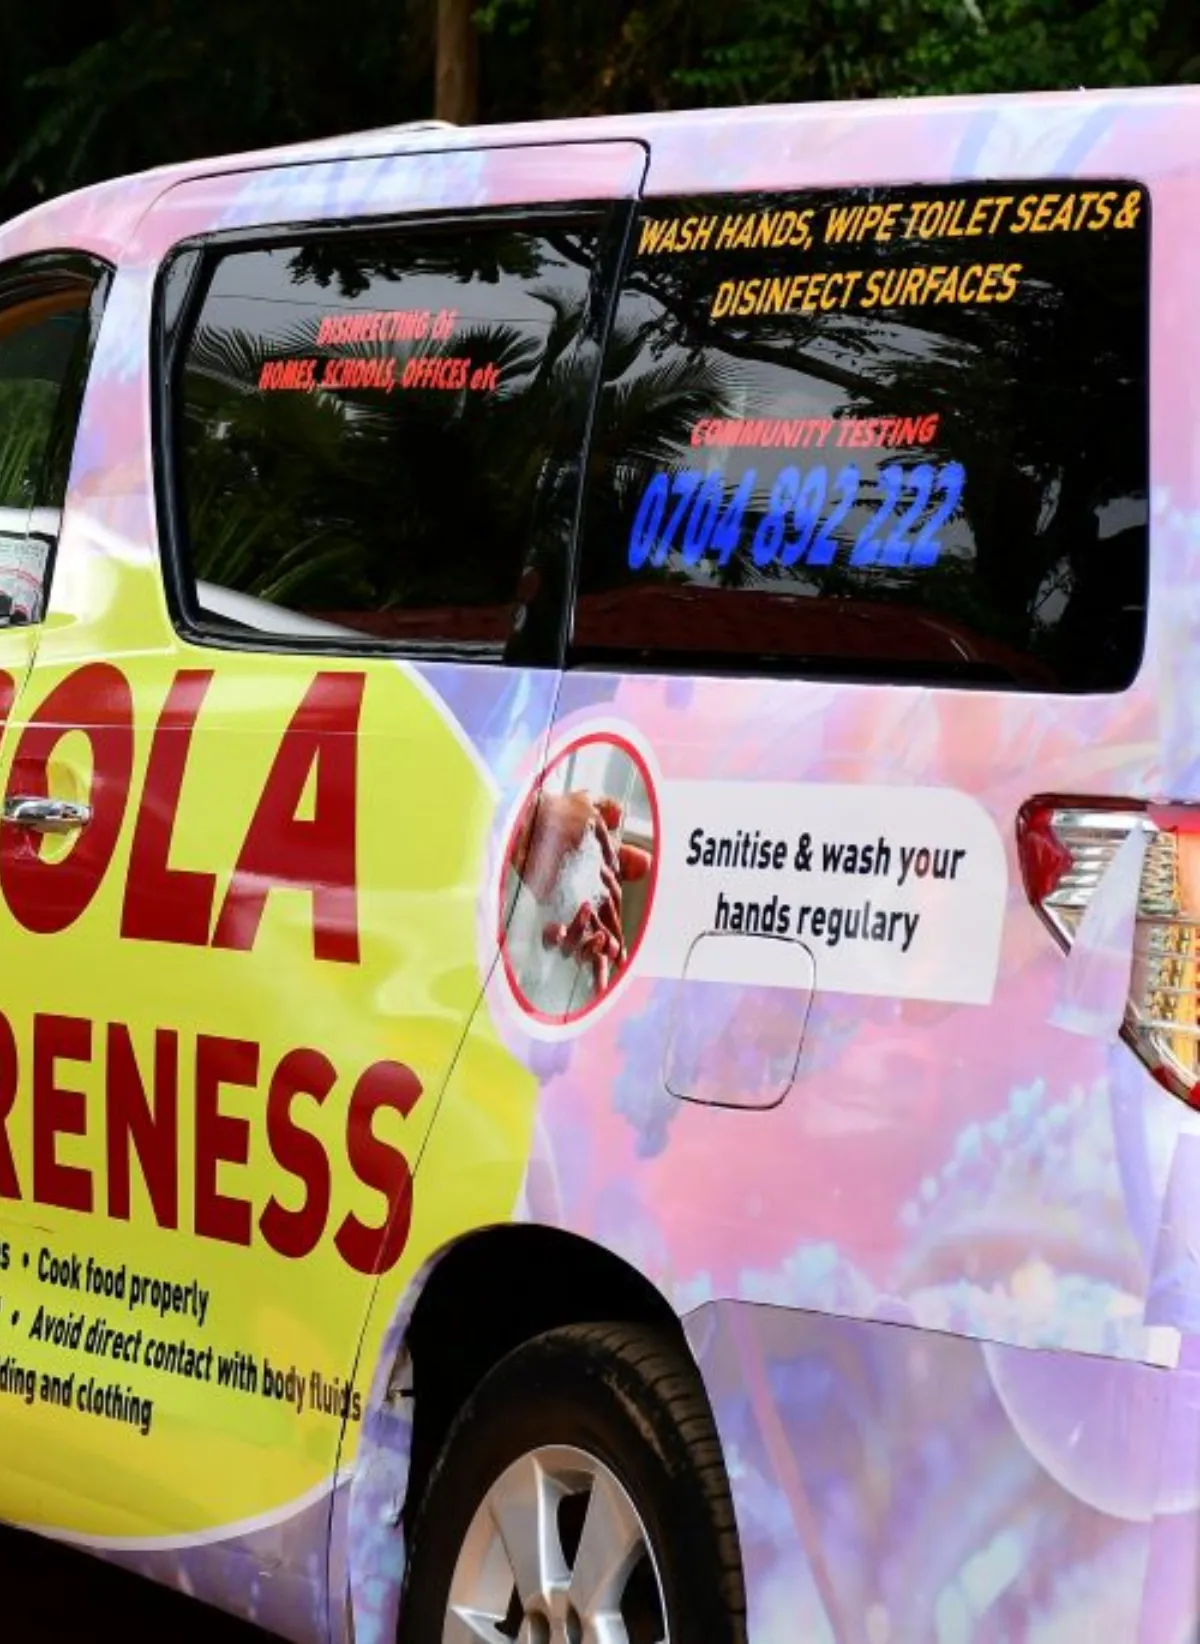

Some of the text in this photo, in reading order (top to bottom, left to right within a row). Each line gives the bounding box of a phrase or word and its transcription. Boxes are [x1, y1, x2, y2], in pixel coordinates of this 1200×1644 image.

[637, 190, 1141, 254] WASH HANDS, WIPE TOILET SEATS &
[711, 262, 1023, 318] DISINFECT SURFACES
[402, 356, 471, 390] OFFICES
[690, 413, 941, 448] COMMUNITY TESTING
[626, 460, 966, 572] 0704 892 222
[686, 828, 966, 887] Sanitise & wash your
[714, 892, 921, 952] hands regulary
[38, 1247, 81, 1290] Cook
[85, 1257, 126, 1300] food
[129, 1274, 210, 1327] properly
[28, 1305, 83, 1350] Avoid
[83, 1317, 143, 1362] direct
[143, 1338, 213, 1382] contact
[218, 1350, 258, 1393] with
[262, 1356, 306, 1415] body
[308, 1370, 362, 1422] fluids
[39, 1372, 75, 1408] and
[75, 1375, 155, 1436] clothing
